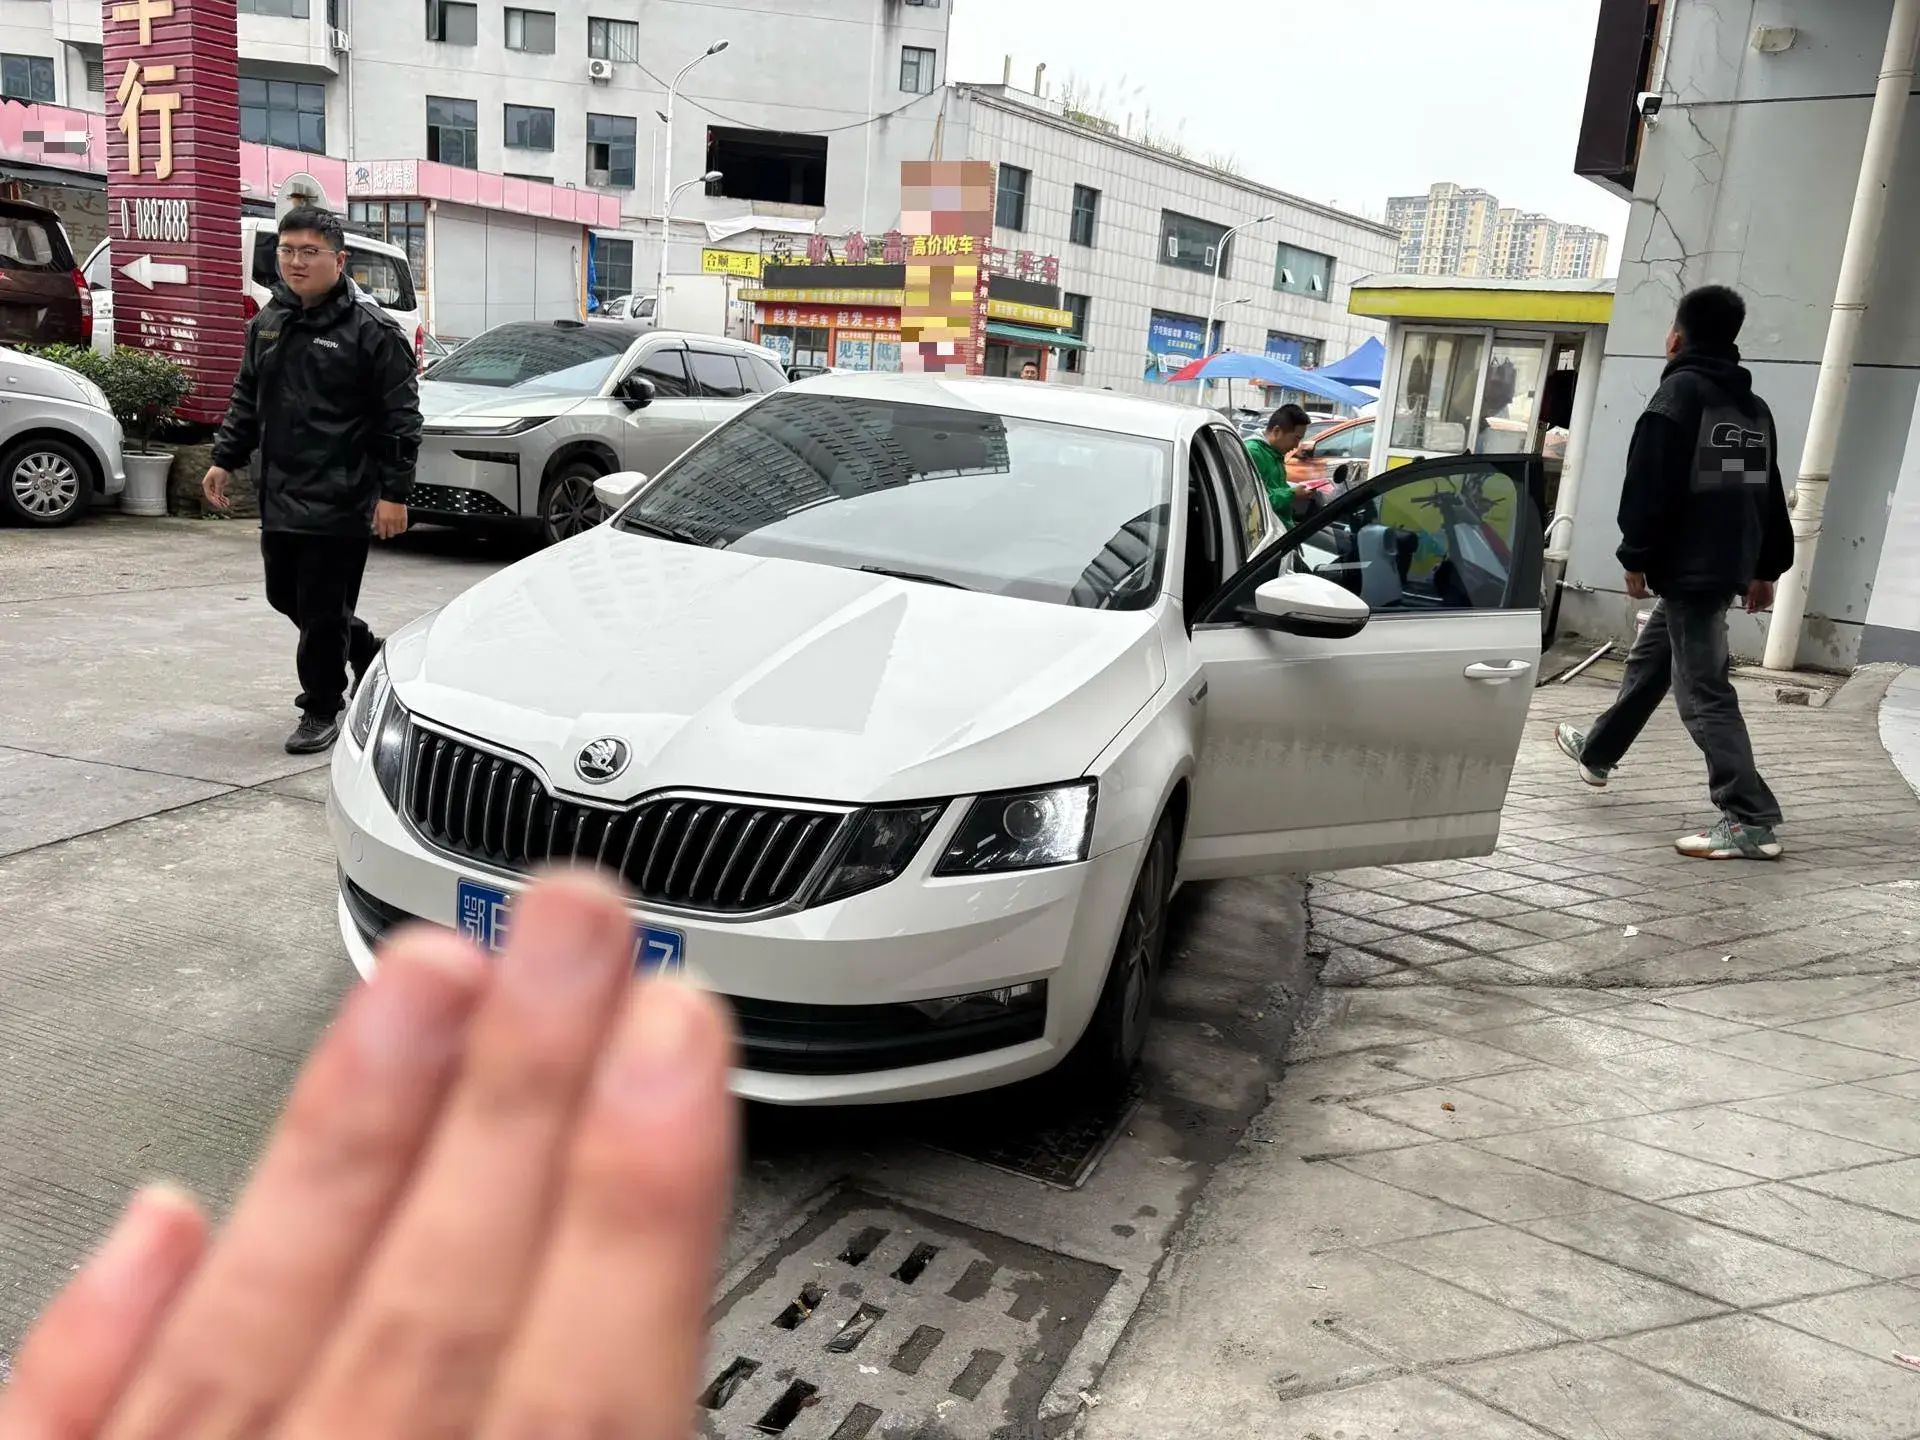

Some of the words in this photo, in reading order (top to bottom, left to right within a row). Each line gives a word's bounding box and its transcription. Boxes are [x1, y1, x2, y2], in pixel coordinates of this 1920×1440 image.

[912, 235, 974, 256] 高价收车
[773, 308, 829, 324] 起发二手车
[837, 311, 896, 328] 起发二手车
